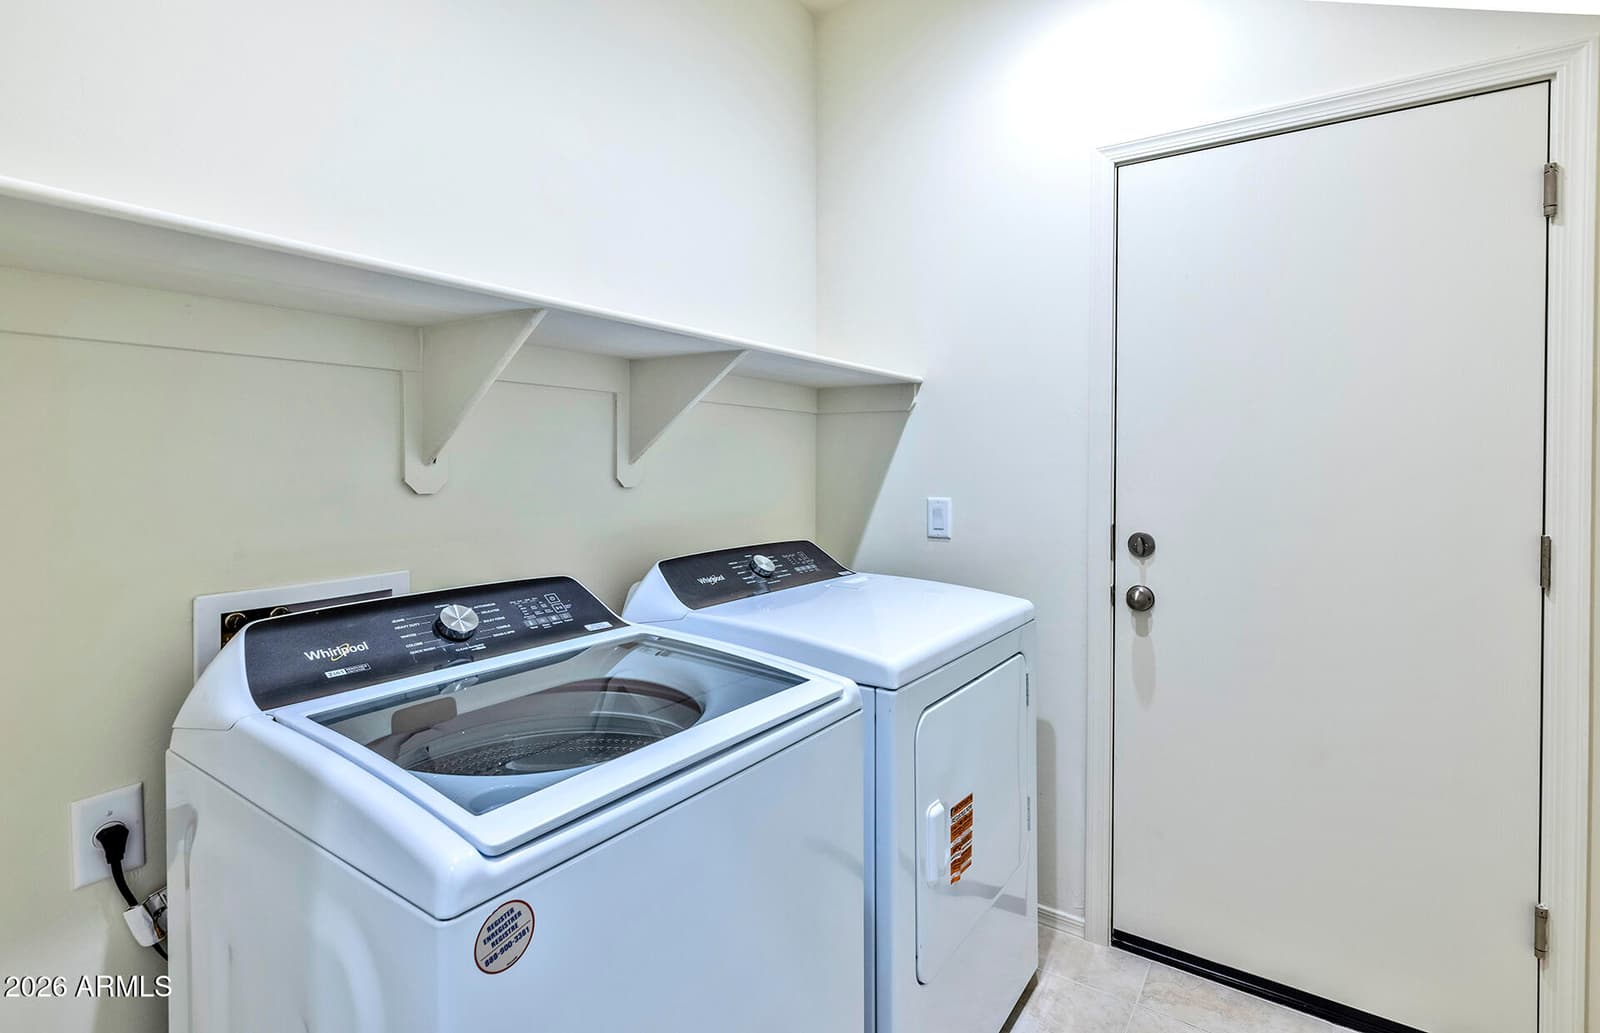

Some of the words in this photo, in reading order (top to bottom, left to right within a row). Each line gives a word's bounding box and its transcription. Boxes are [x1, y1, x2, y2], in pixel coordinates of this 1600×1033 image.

[303, 641, 369, 661] Whirlpool
[486, 906, 515, 933] REGISTER
[490, 922, 518, 948] REGISTRE
